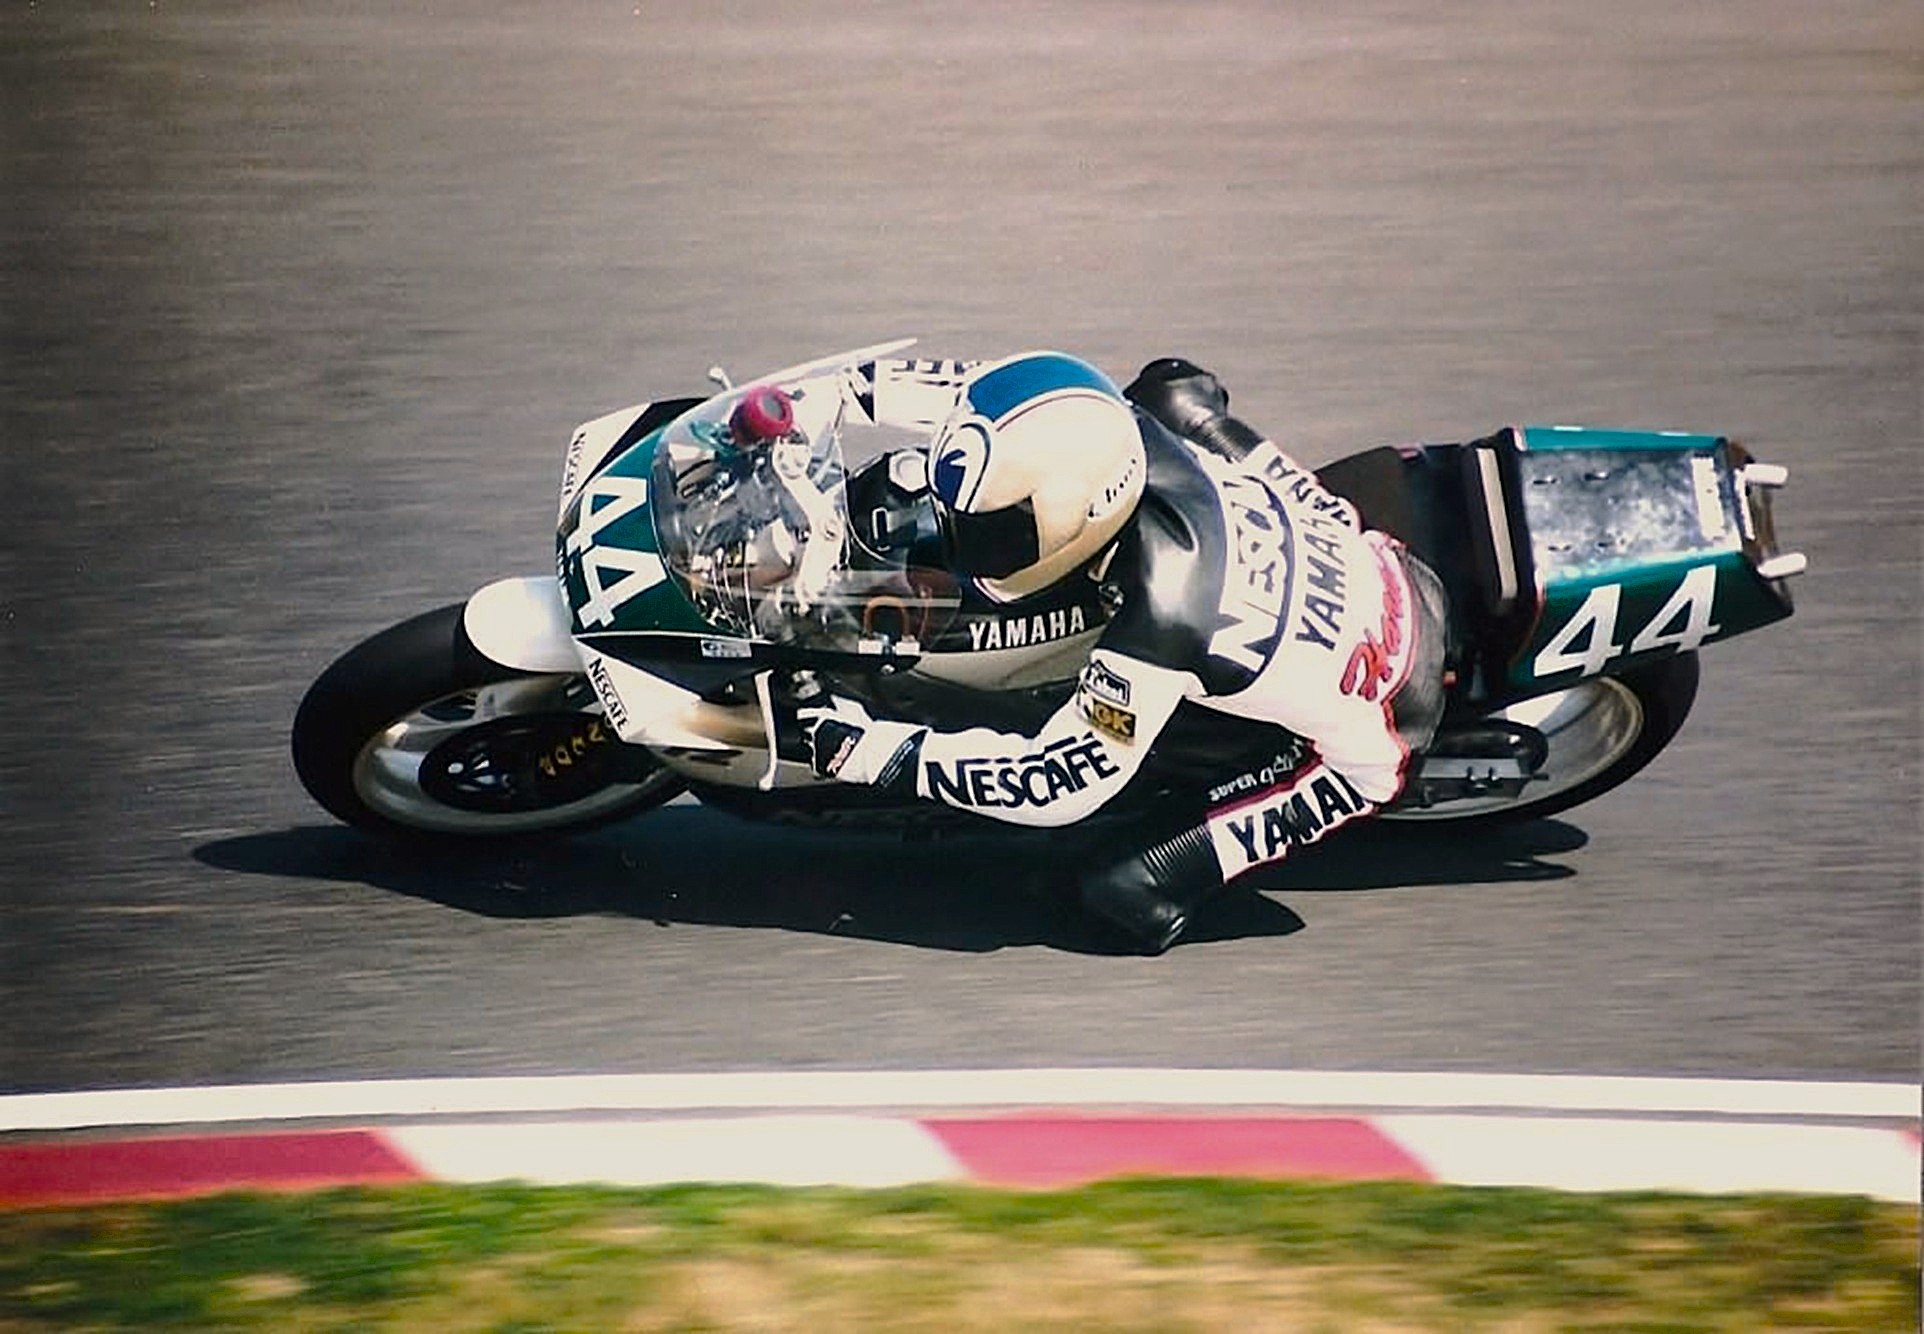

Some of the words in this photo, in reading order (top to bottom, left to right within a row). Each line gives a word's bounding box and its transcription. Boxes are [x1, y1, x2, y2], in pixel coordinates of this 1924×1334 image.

[566, 476, 667, 630] 44
[969, 606, 1086, 651] YAMAHA
[1534, 564, 1721, 677] 44
